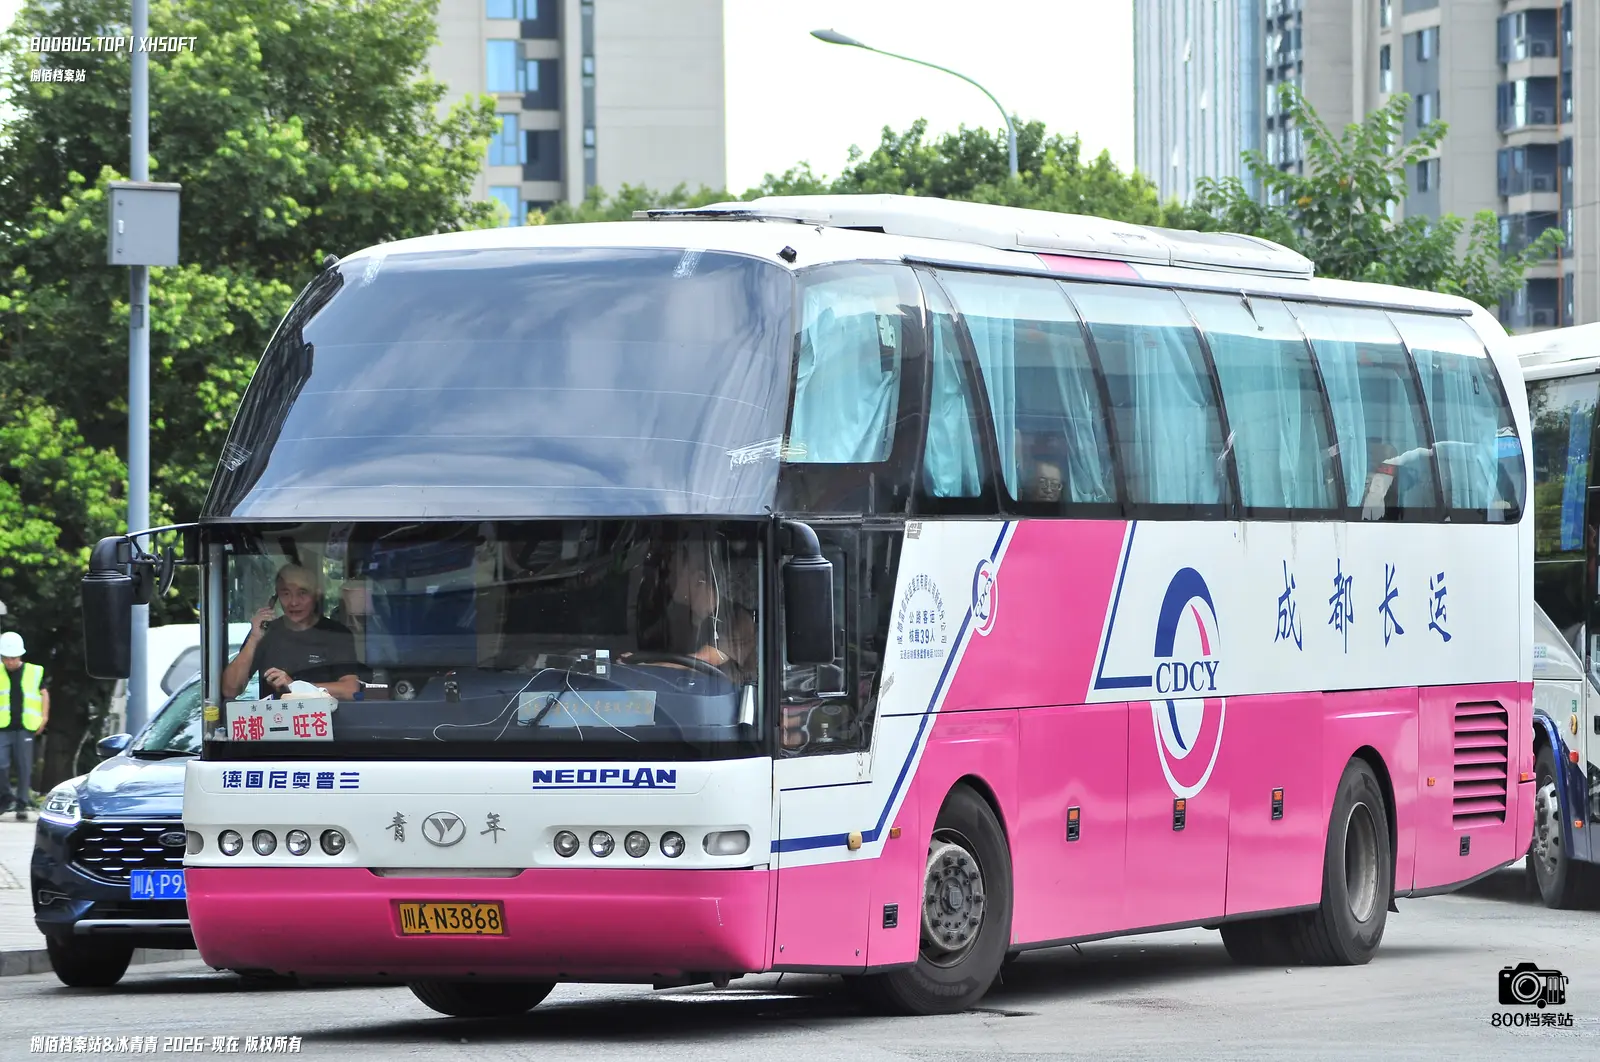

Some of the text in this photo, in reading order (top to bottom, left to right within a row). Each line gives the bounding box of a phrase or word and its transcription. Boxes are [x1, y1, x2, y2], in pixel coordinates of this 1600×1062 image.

[1273, 558, 1451, 653] 成都长运
[1156, 660, 1219, 693] CDCY
[222, 770, 360, 789] 德国尼奥普兰
[532, 767, 677, 788] NEOPLAN
[133, 874, 186, 896] 川A·P9
